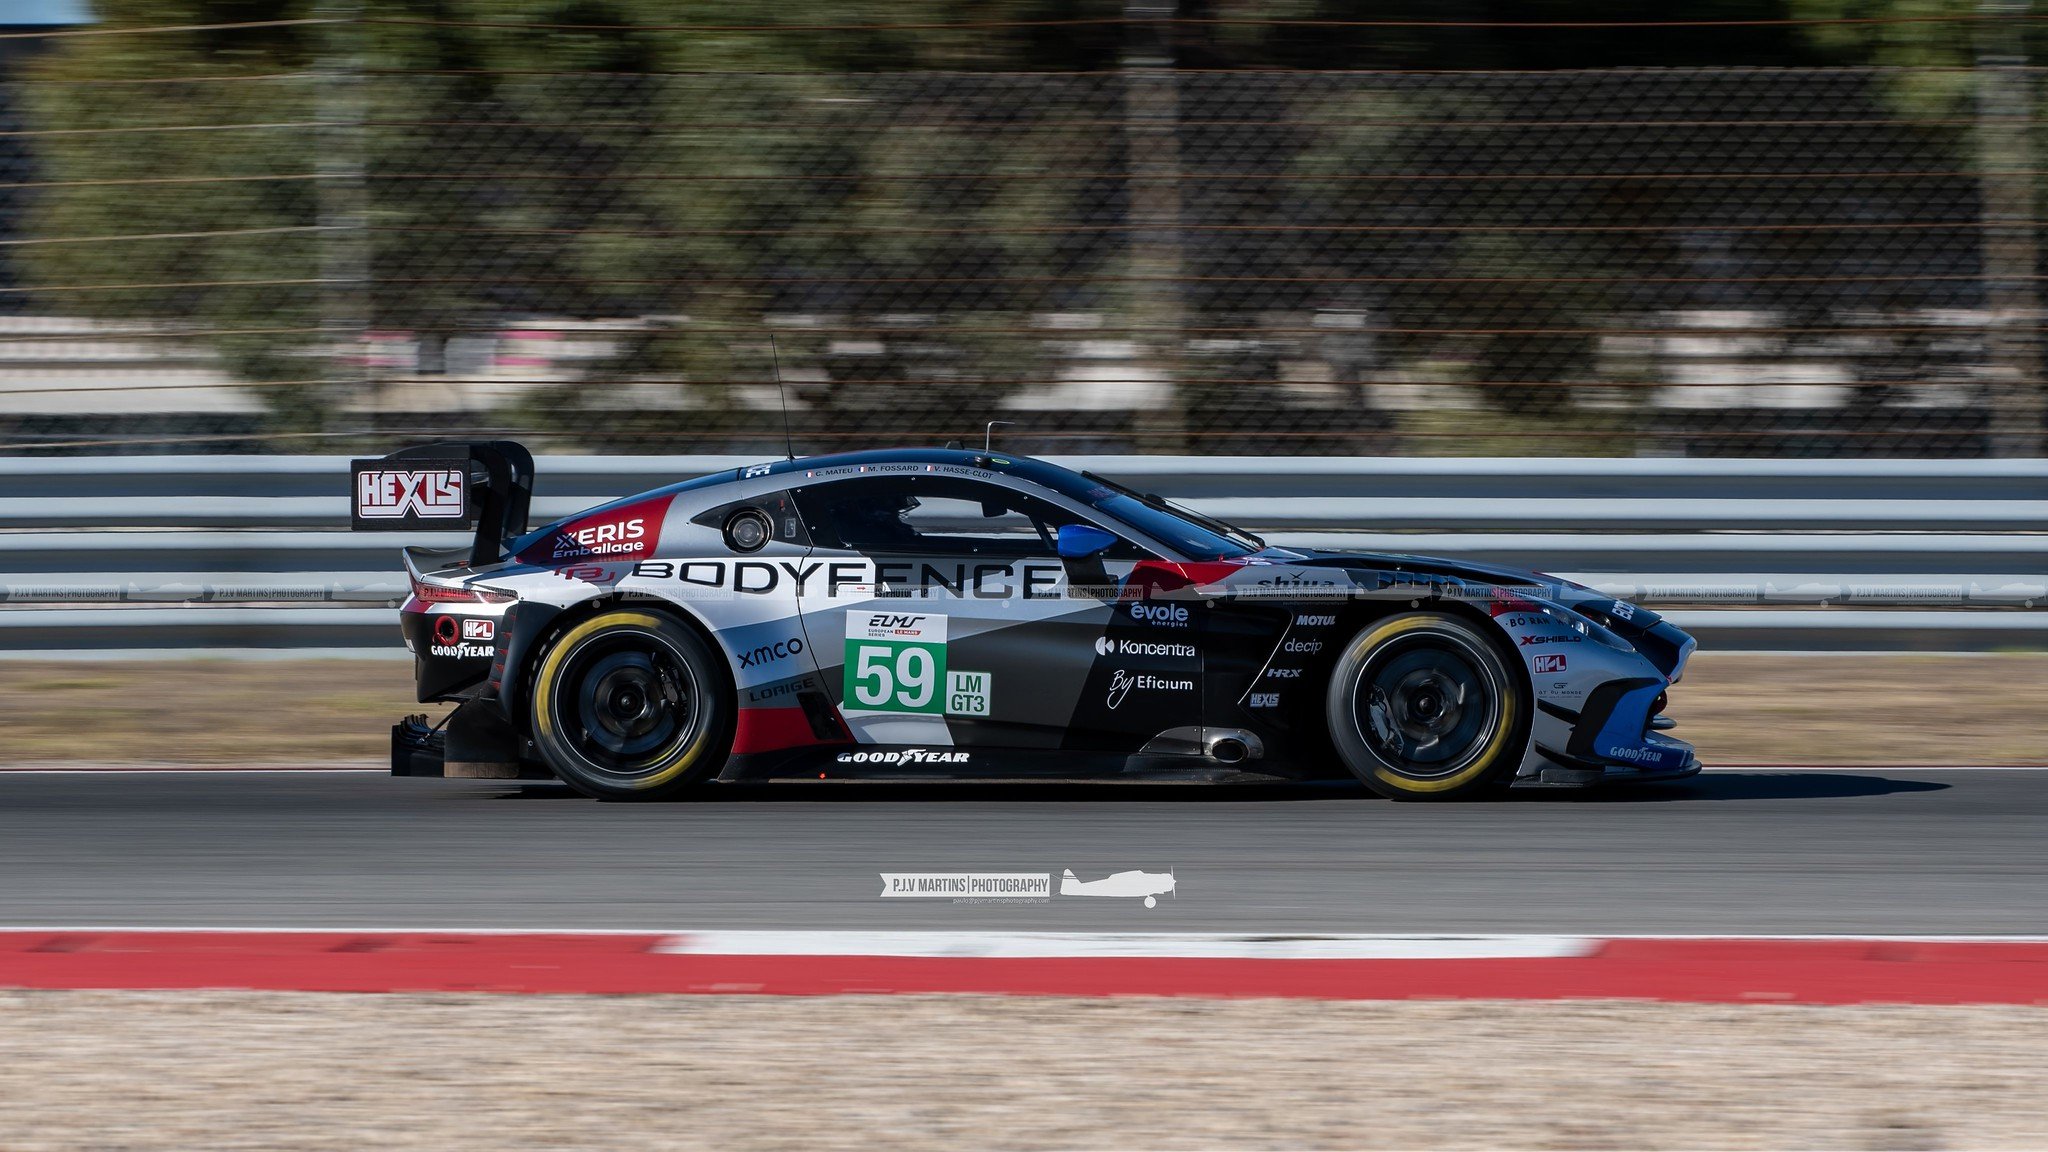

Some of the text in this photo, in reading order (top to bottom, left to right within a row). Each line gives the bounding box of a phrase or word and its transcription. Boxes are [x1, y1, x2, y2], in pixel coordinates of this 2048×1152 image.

[826, 467, 853, 476] MATEU
[943, 467, 993, 479] HASSE-CLOT
[361, 473, 460, 515] HEXIS
[552, 541, 645, 558] Emballage
[631, 562, 1062, 600] BODYFENCE
[1130, 601, 1188, 621] évole
[465, 621, 492, 637] HPL
[1296, 615, 1336, 626] MOTUL
[431, 643, 494, 659] GOODYEAR
[737, 638, 803, 669] xmco
[1120, 639, 1195, 657] Koncentra
[1284, 638, 1323, 655] decip
[854, 645, 935, 707] 59
[955, 674, 982, 693] LM
[1107, 669, 1193, 709] By Eficium
[951, 694, 985, 712] GT3
[1250, 693, 1280, 708] HEXIS
[836, 749, 970, 766] GOODYEAR
[1610, 747, 1662, 762] GOODYEAR
